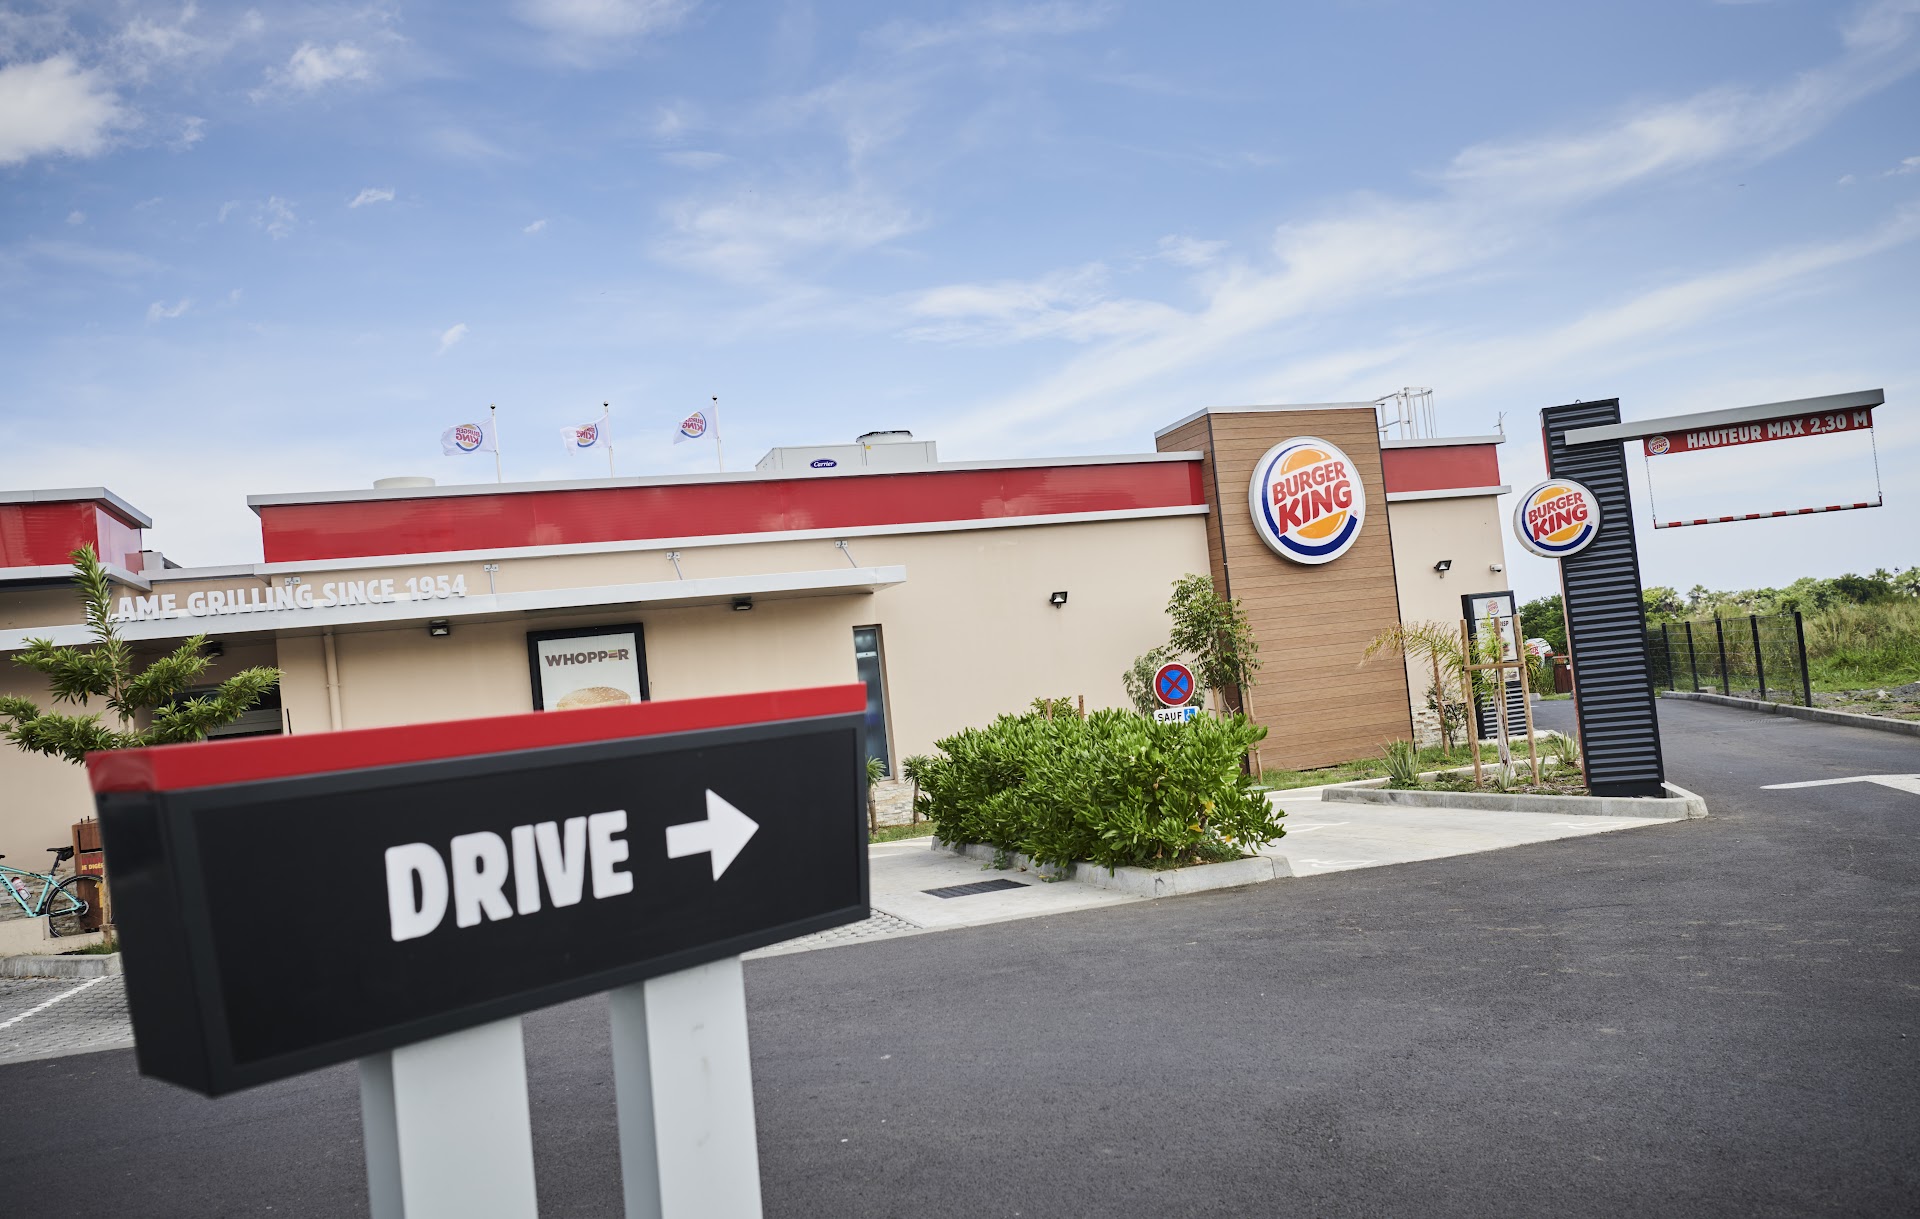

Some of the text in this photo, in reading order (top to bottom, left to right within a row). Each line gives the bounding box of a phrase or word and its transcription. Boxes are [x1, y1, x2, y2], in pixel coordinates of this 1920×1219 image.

[1686, 410, 1869, 449] HAUTEUR MAX 2,30 M
[1272, 461, 1346, 506] BURGER
[1279, 479, 1352, 535] KING
[1528, 492, 1583, 524] BURGER
[1533, 503, 1588, 541] KING
[86, 574, 468, 624] AME GRILLING SINCE 1954
[545, 648, 629, 667] WHOPPER
[1158, 711, 1182, 721] SAUF
[385, 809, 634, 942] DRIVE
